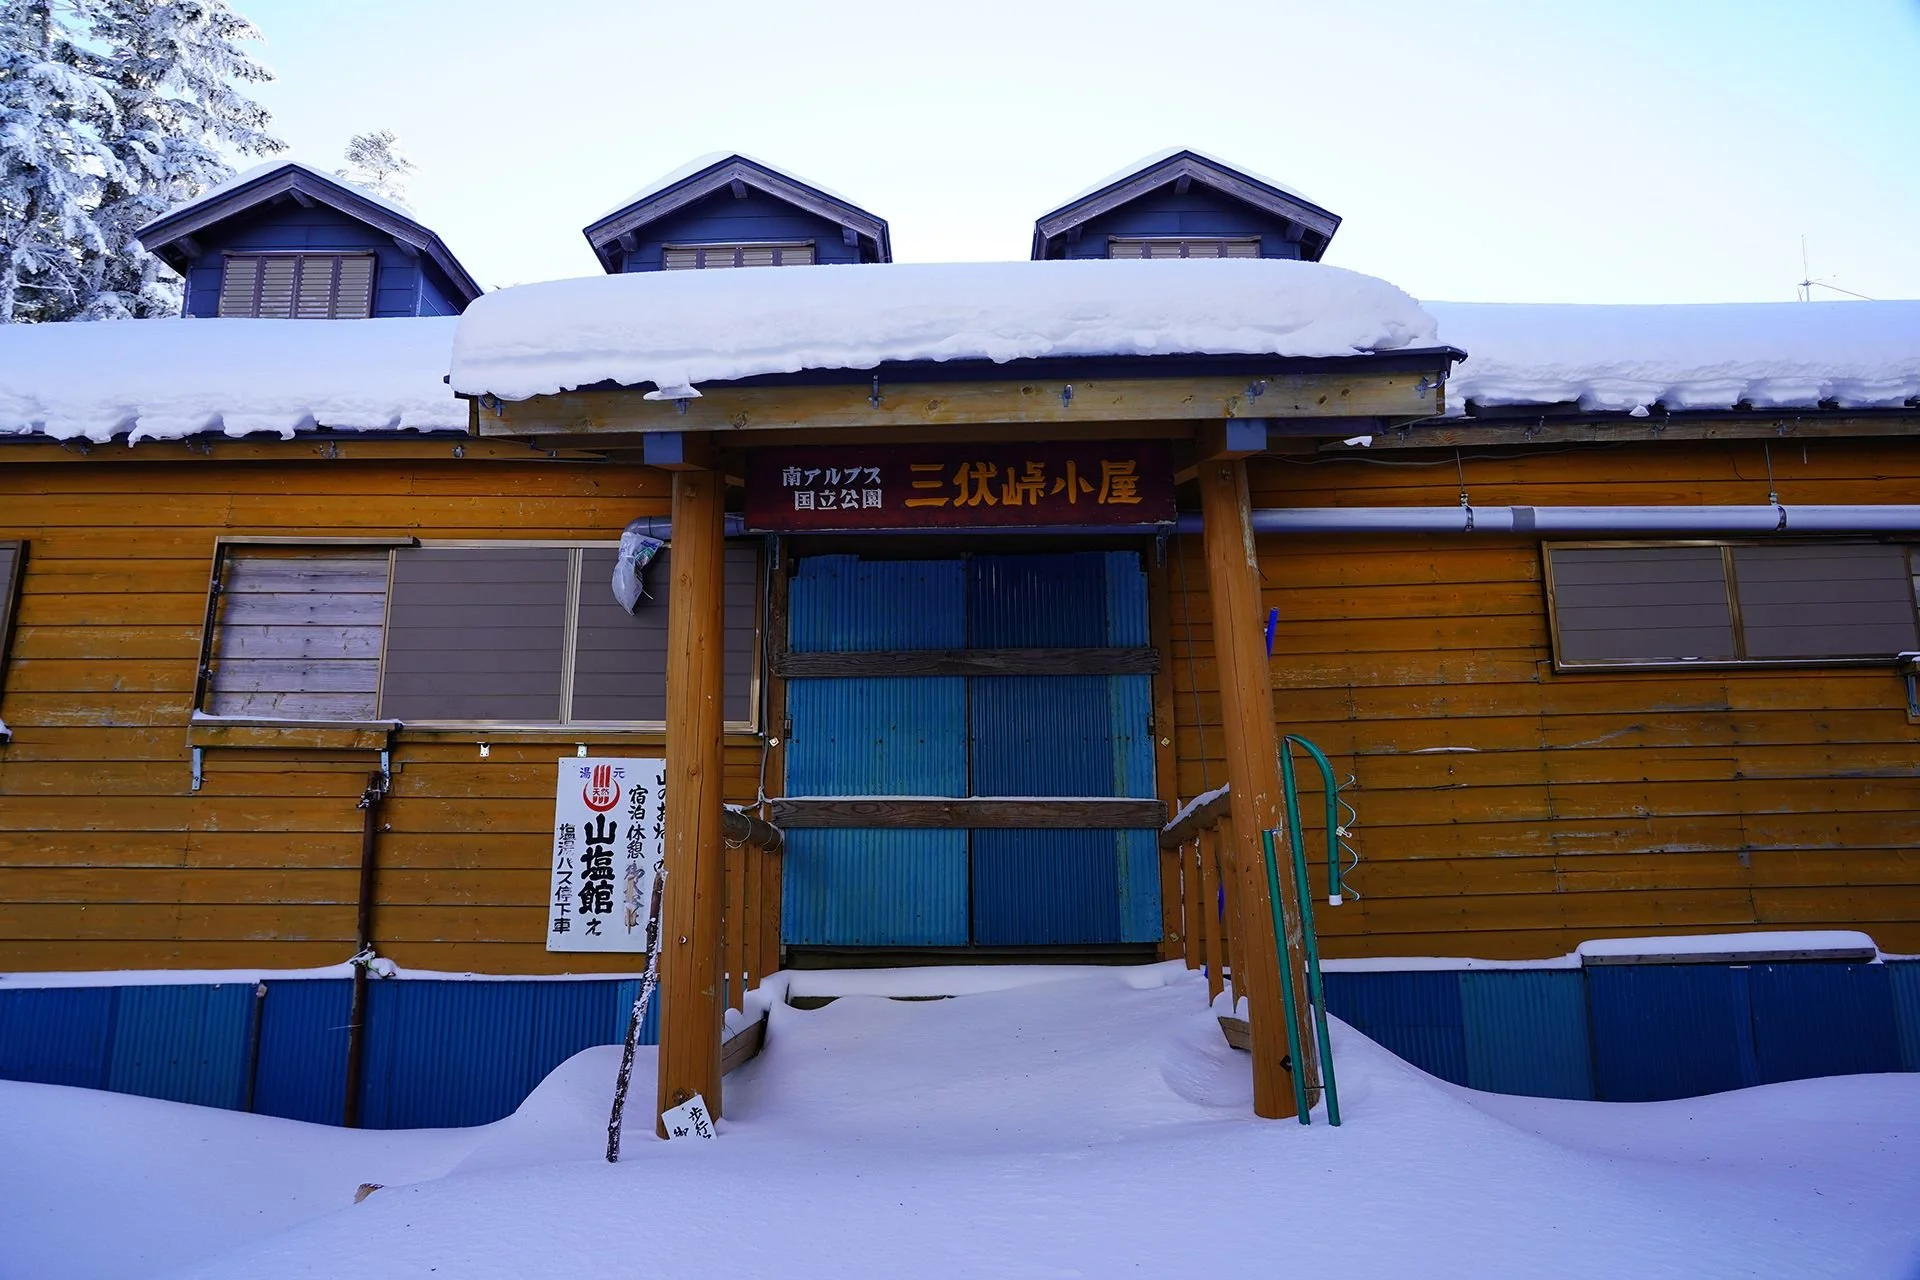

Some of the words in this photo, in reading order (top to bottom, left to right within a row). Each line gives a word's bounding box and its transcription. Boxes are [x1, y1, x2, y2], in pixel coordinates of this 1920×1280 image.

[782, 465, 882, 487] 南アルプス
[905, 460, 1142, 507] 三伏峠小屋
[793, 488, 883, 511] 国立公園
